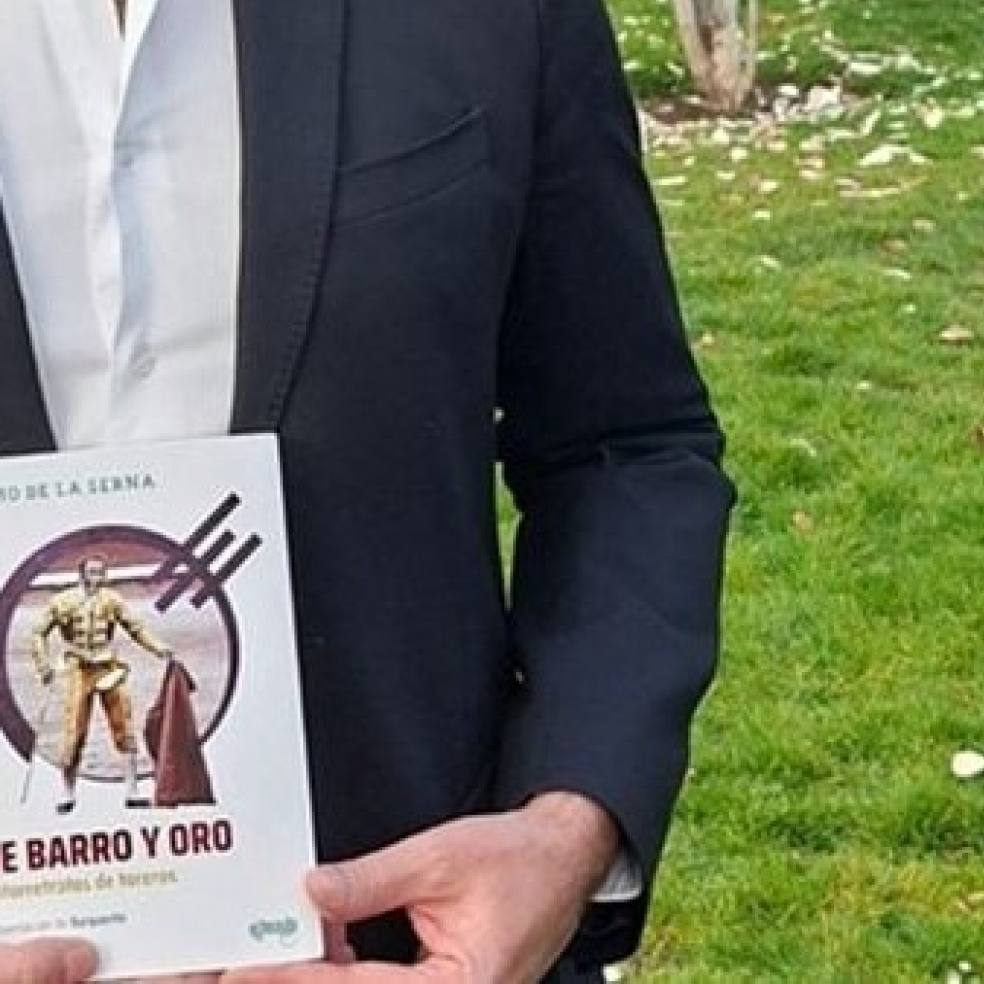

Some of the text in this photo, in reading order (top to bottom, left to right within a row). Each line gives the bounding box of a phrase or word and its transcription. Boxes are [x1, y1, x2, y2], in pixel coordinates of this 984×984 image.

[25, 482, 50, 501] DE
[55, 479, 83, 498] LA
[87, 473, 156, 495] SERNA
[25, 829, 133, 871] BARRO
[139, 825, 161, 859] Y
[168, 819, 234, 857] ORO
[95, 873, 115, 892] de
